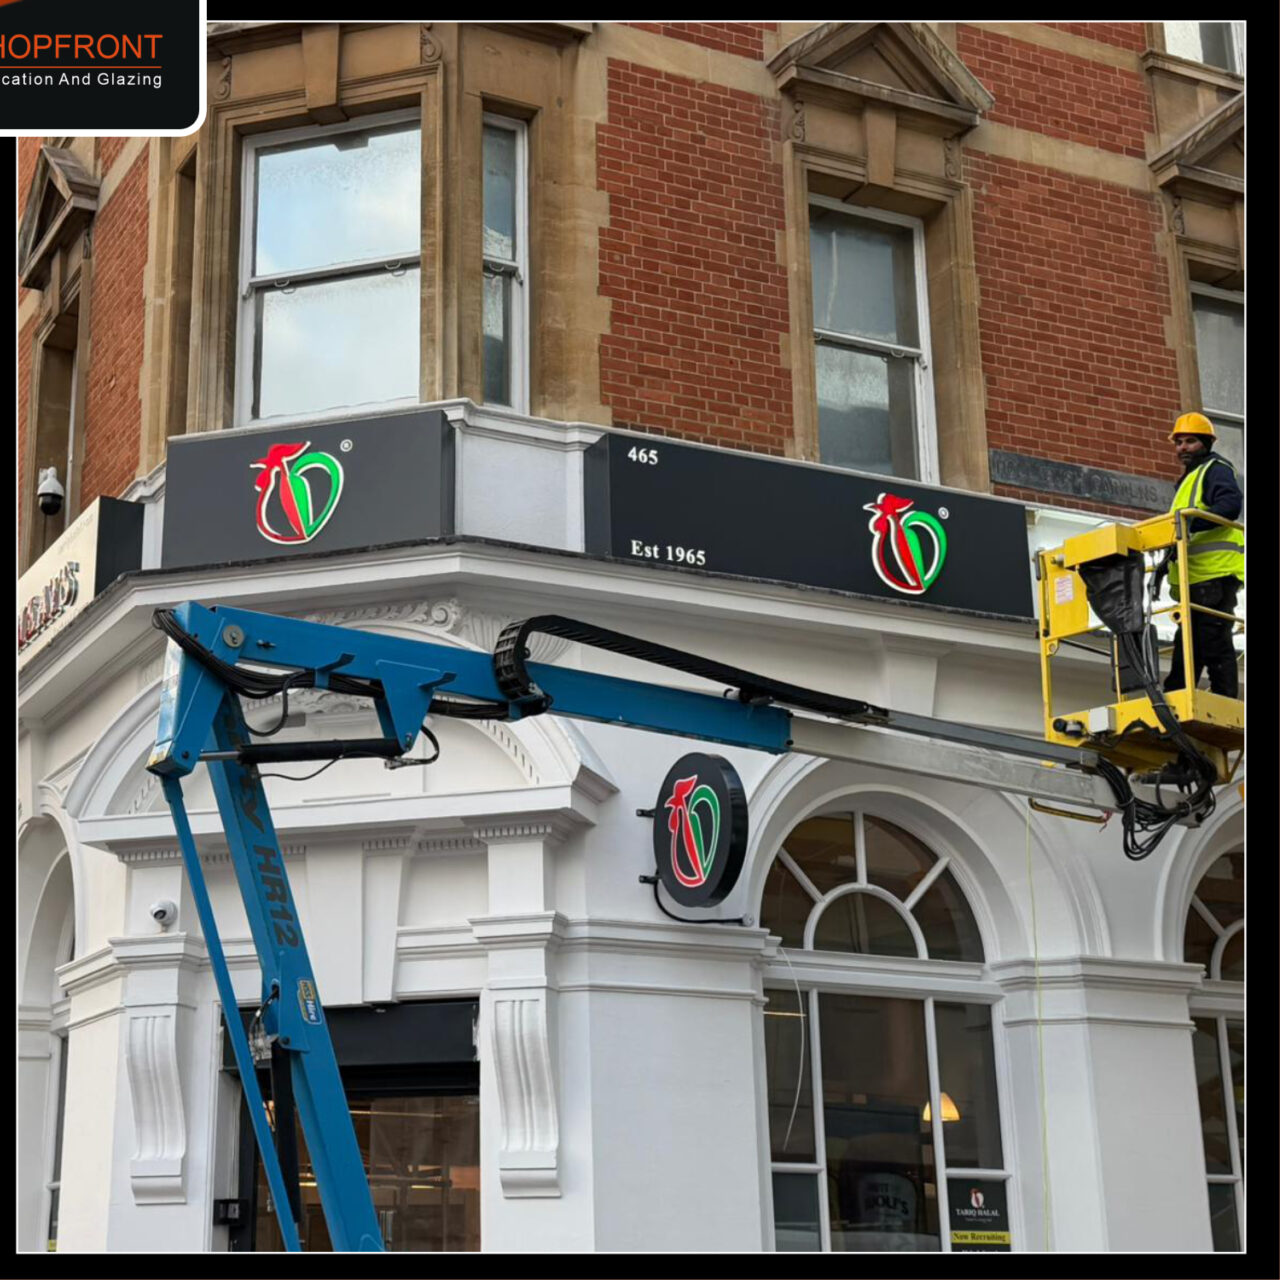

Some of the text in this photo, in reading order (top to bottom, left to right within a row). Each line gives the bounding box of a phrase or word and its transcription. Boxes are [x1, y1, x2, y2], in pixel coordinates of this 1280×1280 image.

[627, 446, 659, 466] 465
[631, 539, 707, 566] Est 1965
[253, 844, 299, 949] HR12
[956, 1208, 977, 1217] TARIQ
[953, 1232, 1006, 1243] Now Recruiting
